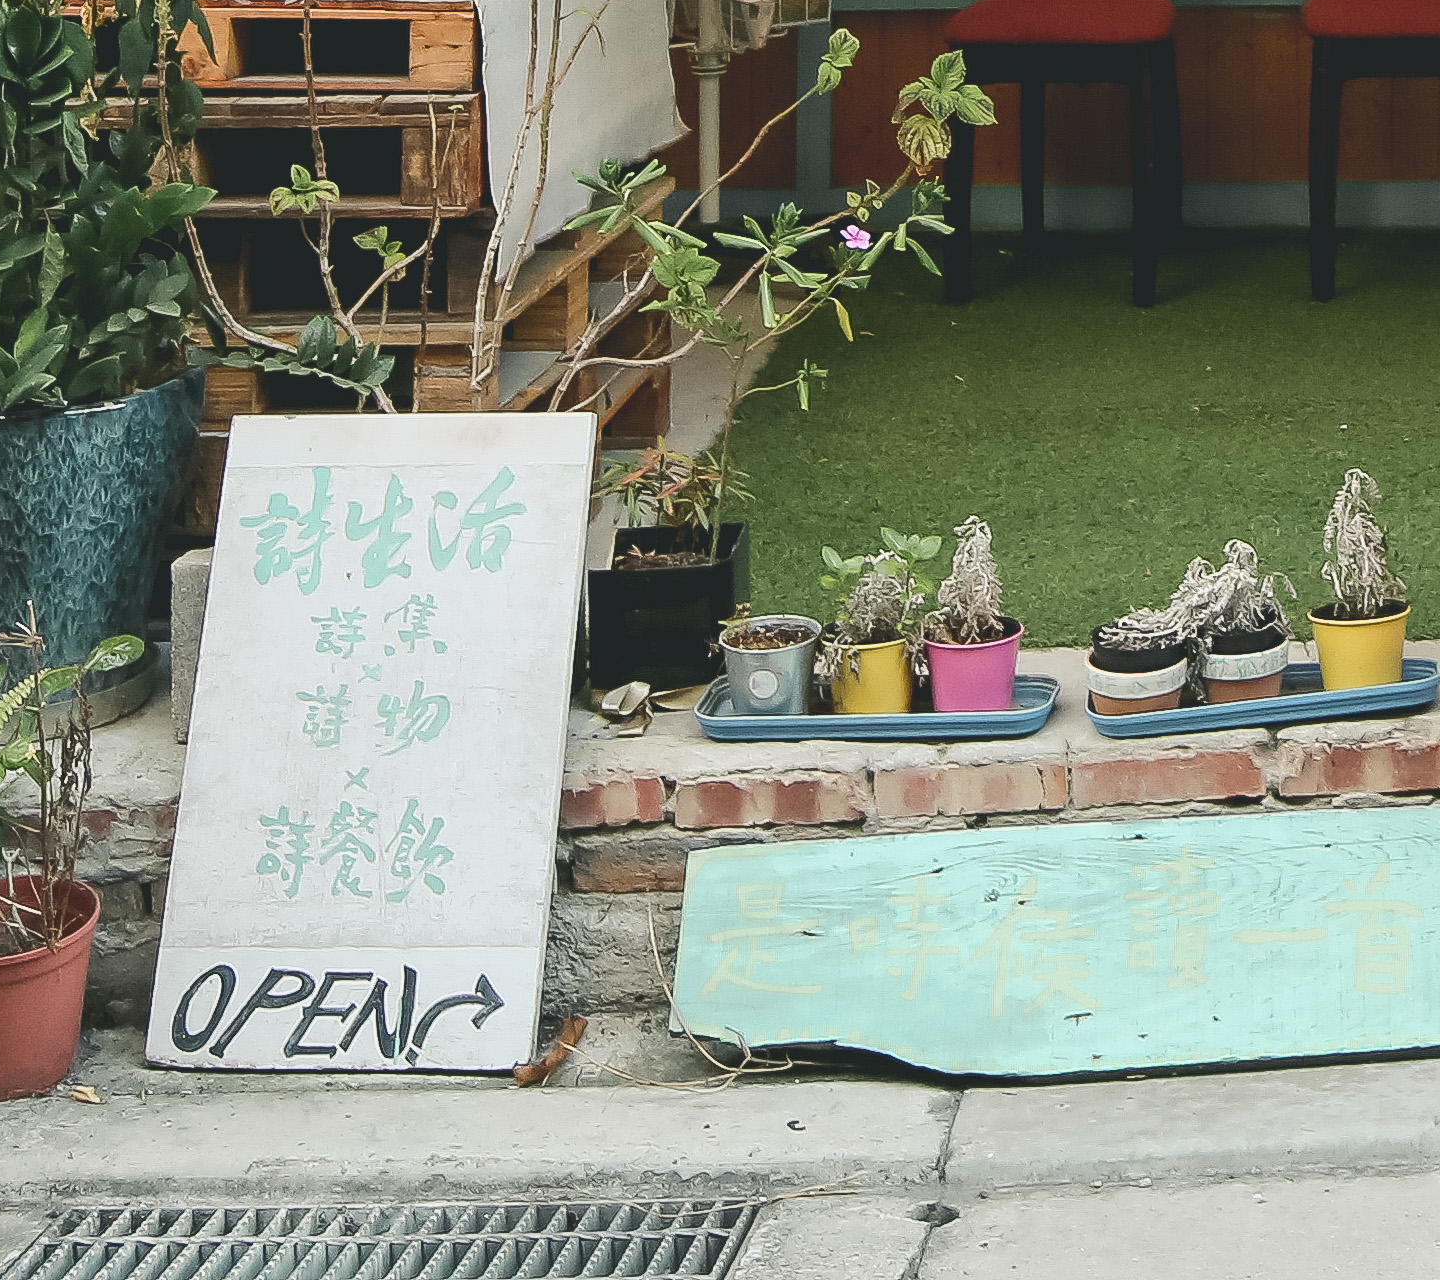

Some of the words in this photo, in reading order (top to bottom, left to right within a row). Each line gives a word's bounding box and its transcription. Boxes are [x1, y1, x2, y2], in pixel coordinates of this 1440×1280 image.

[240, 466, 528, 595] 詩生活
[311, 595, 448, 659] 詩集
[296, 680, 452, 756] 詩物
[257, 799, 454, 903] 詩餐飲
[171, 963, 420, 1065] OPEN
